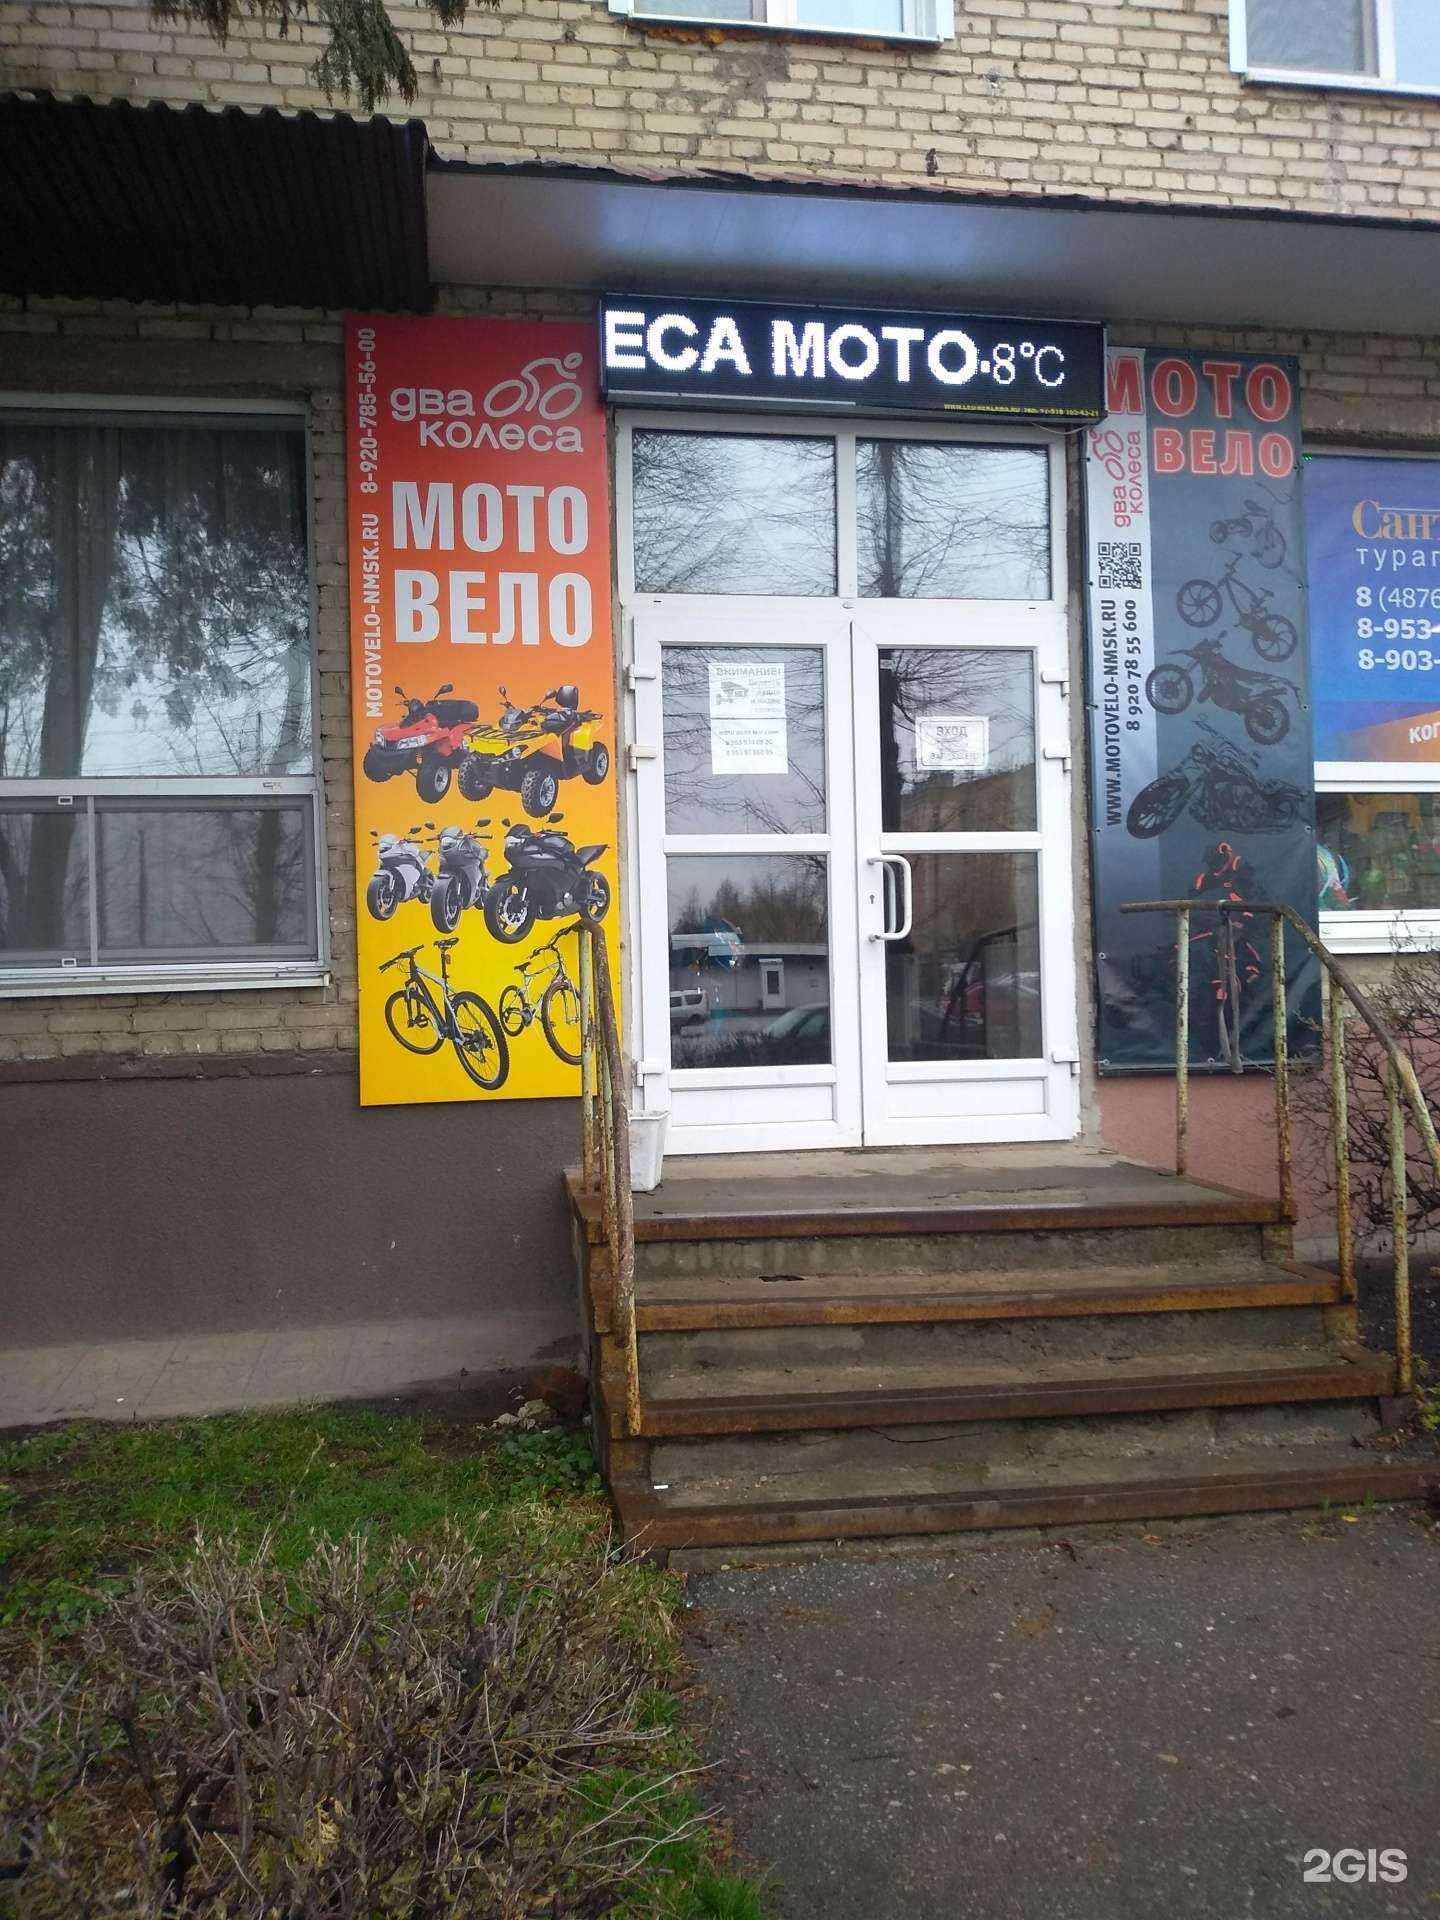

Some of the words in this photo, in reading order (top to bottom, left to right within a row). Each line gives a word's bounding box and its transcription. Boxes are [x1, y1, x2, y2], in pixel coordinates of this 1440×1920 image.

[604, 310, 752, 375] ЕСА
[770, 320, 978, 386] МОТО
[358, 327, 379, 494] 8-920-785-56-00
[390, 387, 476, 422] два
[1107, 356, 1292, 424] МОТО
[419, 420, 584, 453] колеса
[1154, 427, 1294, 478] ВЕЛО
[1127, 431, 1143, 514] колеса
[392, 480, 589, 556] МОТО
[1113, 485, 1131, 528] два
[362, 513, 384, 719] MOTOVELO-NMSK.RU
[394, 569, 593, 648] ВЕЛО
[1122, 599, 1138, 632] 600
[1356, 586, 1373, 608] 8
[1378, 586, 1440, 613] (4876
[1124, 636, 1141, 655] 55
[1125, 659, 1142, 680] 78
[1102, 600, 1122, 826] WWW.MOTOVELO-NMSK.RU
[1128, 684, 1143, 715] 920
[1126, 720, 1141, 731] 8
